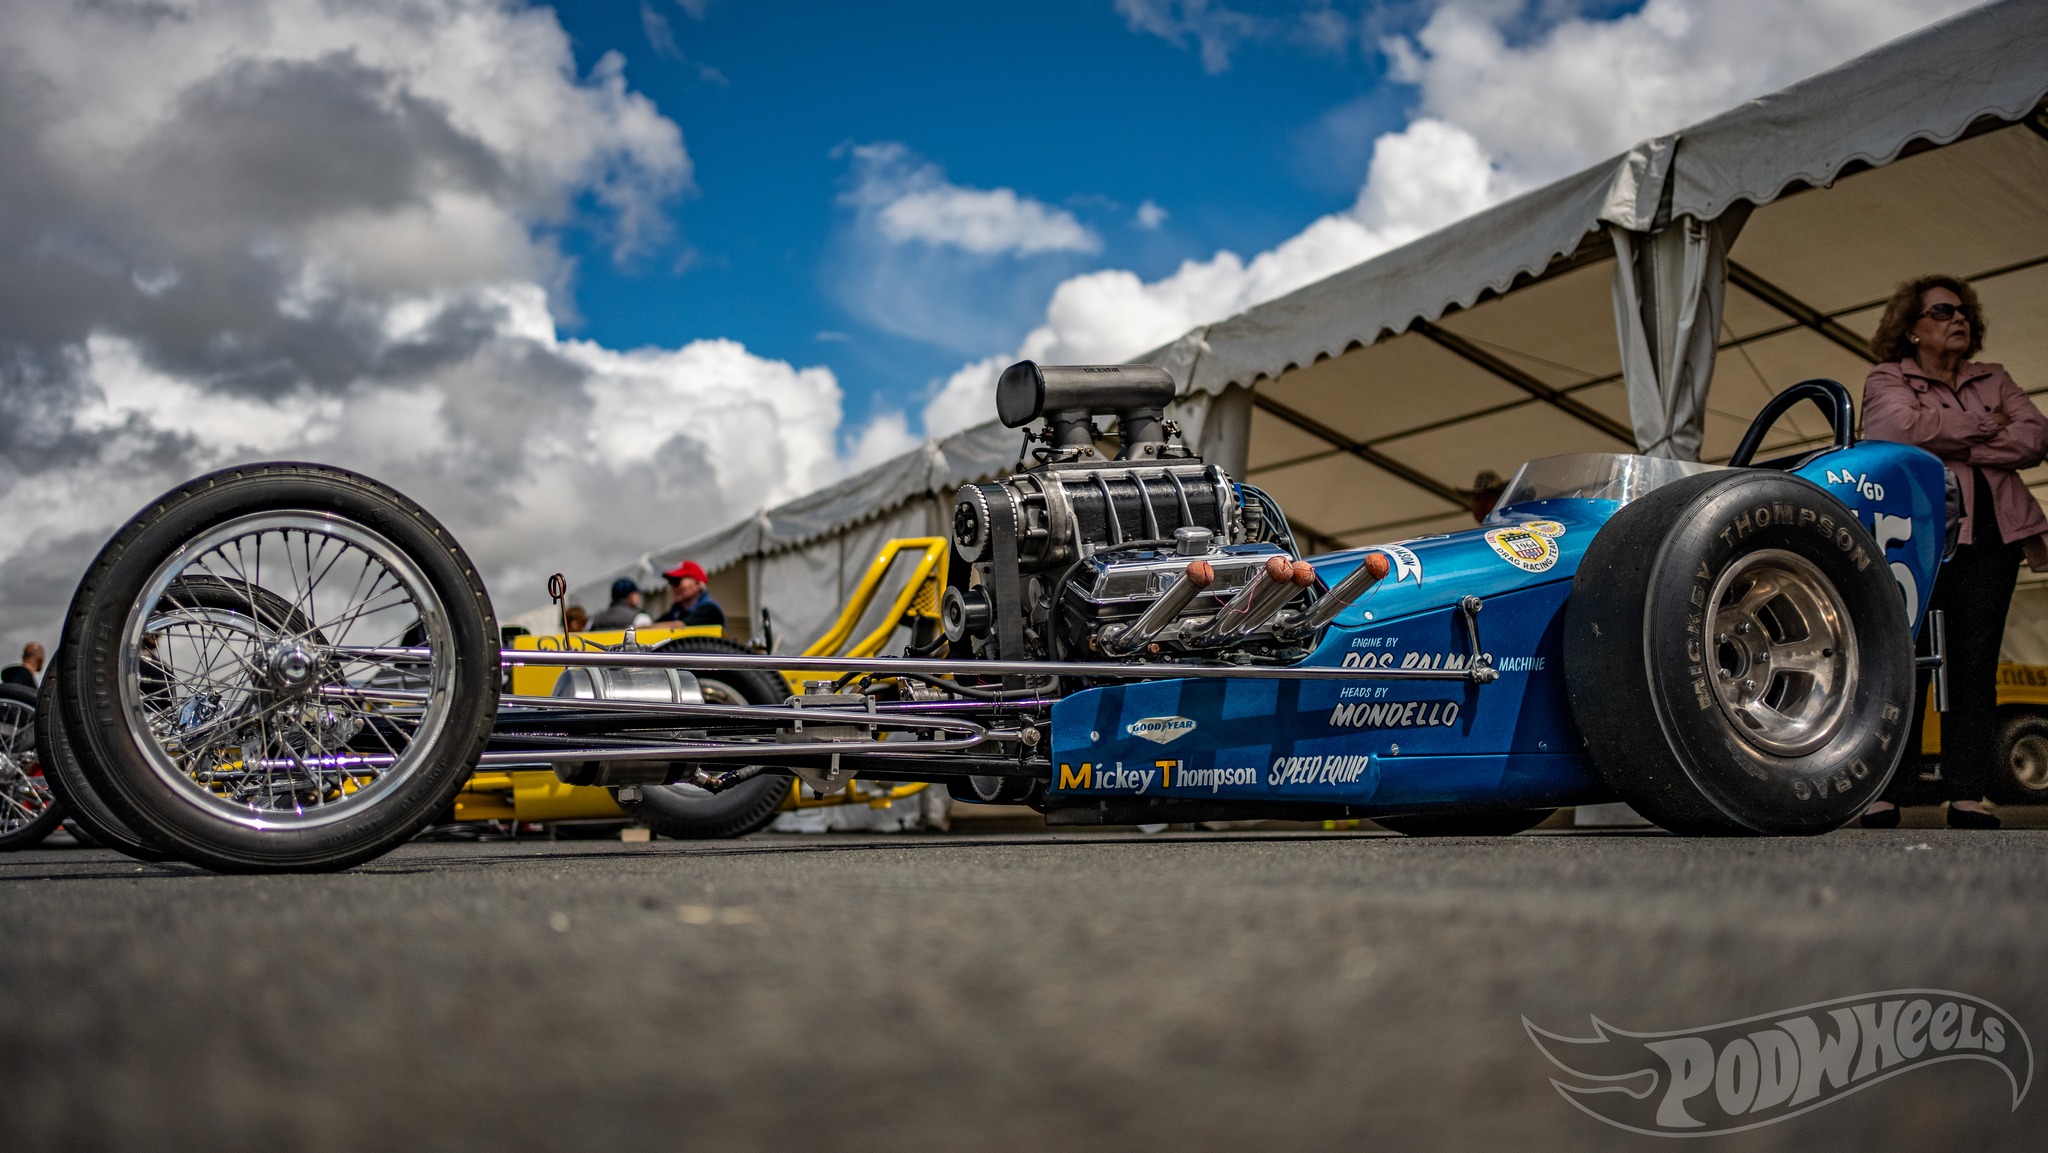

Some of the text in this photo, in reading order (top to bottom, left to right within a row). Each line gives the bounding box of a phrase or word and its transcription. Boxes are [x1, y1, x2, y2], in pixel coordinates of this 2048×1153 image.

[1826, 468, 1885, 501] AA/GD
[1496, 539, 1557, 571] DRAG RACING TEAM
[1515, 541, 1538, 550] 1964
[1686, 501, 1871, 711] MICKEY THOMPSON
[1351, 637, 1398, 648] ENGINE BY
[1499, 656, 1545, 671] MACHINE
[1340, 687, 1388, 698] HEADS BY
[1329, 702, 1459, 727] MONDELLO
[1058, 755, 1369, 795] Mickey Thompson SPEED EQUIP.
[1793, 756, 1870, 801] DRAG
